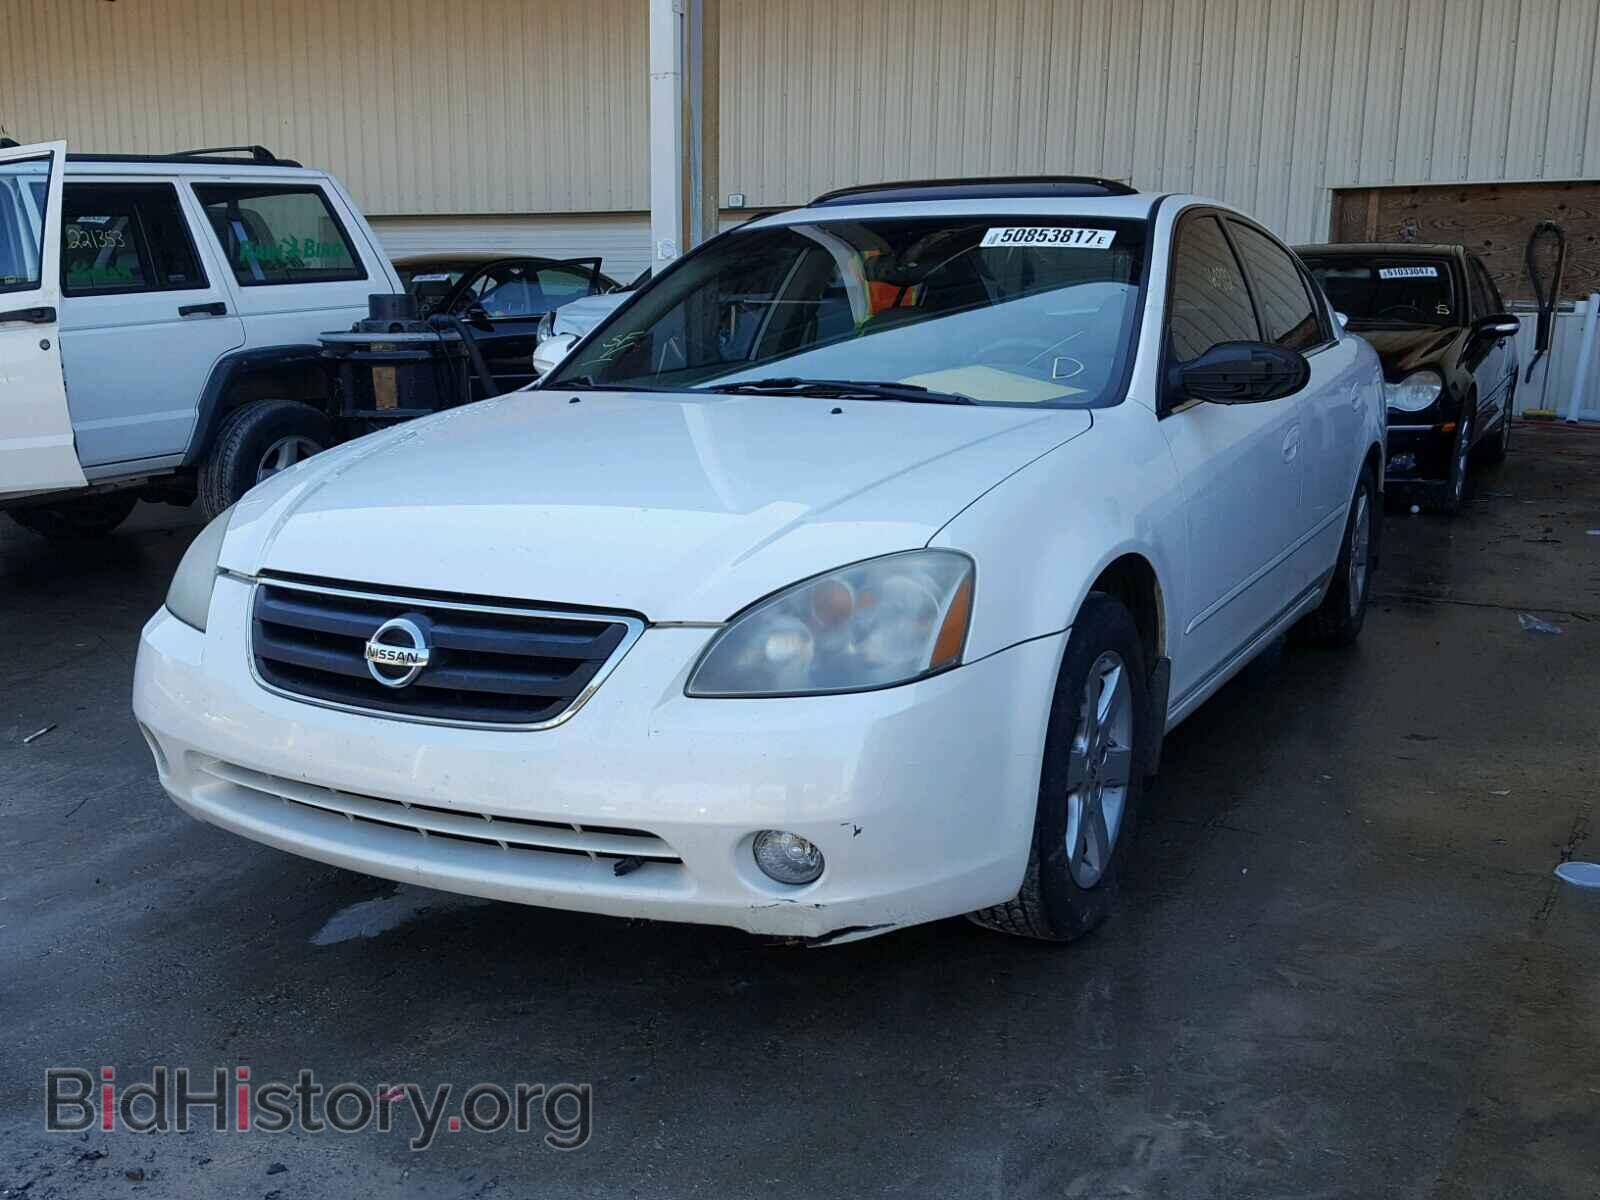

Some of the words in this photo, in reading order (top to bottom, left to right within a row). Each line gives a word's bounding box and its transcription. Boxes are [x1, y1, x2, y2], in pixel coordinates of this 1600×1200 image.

[67, 228, 126, 249] 221353
[1000, 229, 1098, 244] 50853817
[1052, 356, 1084, 379] D
[367, 645, 418, 664] NISSAN
